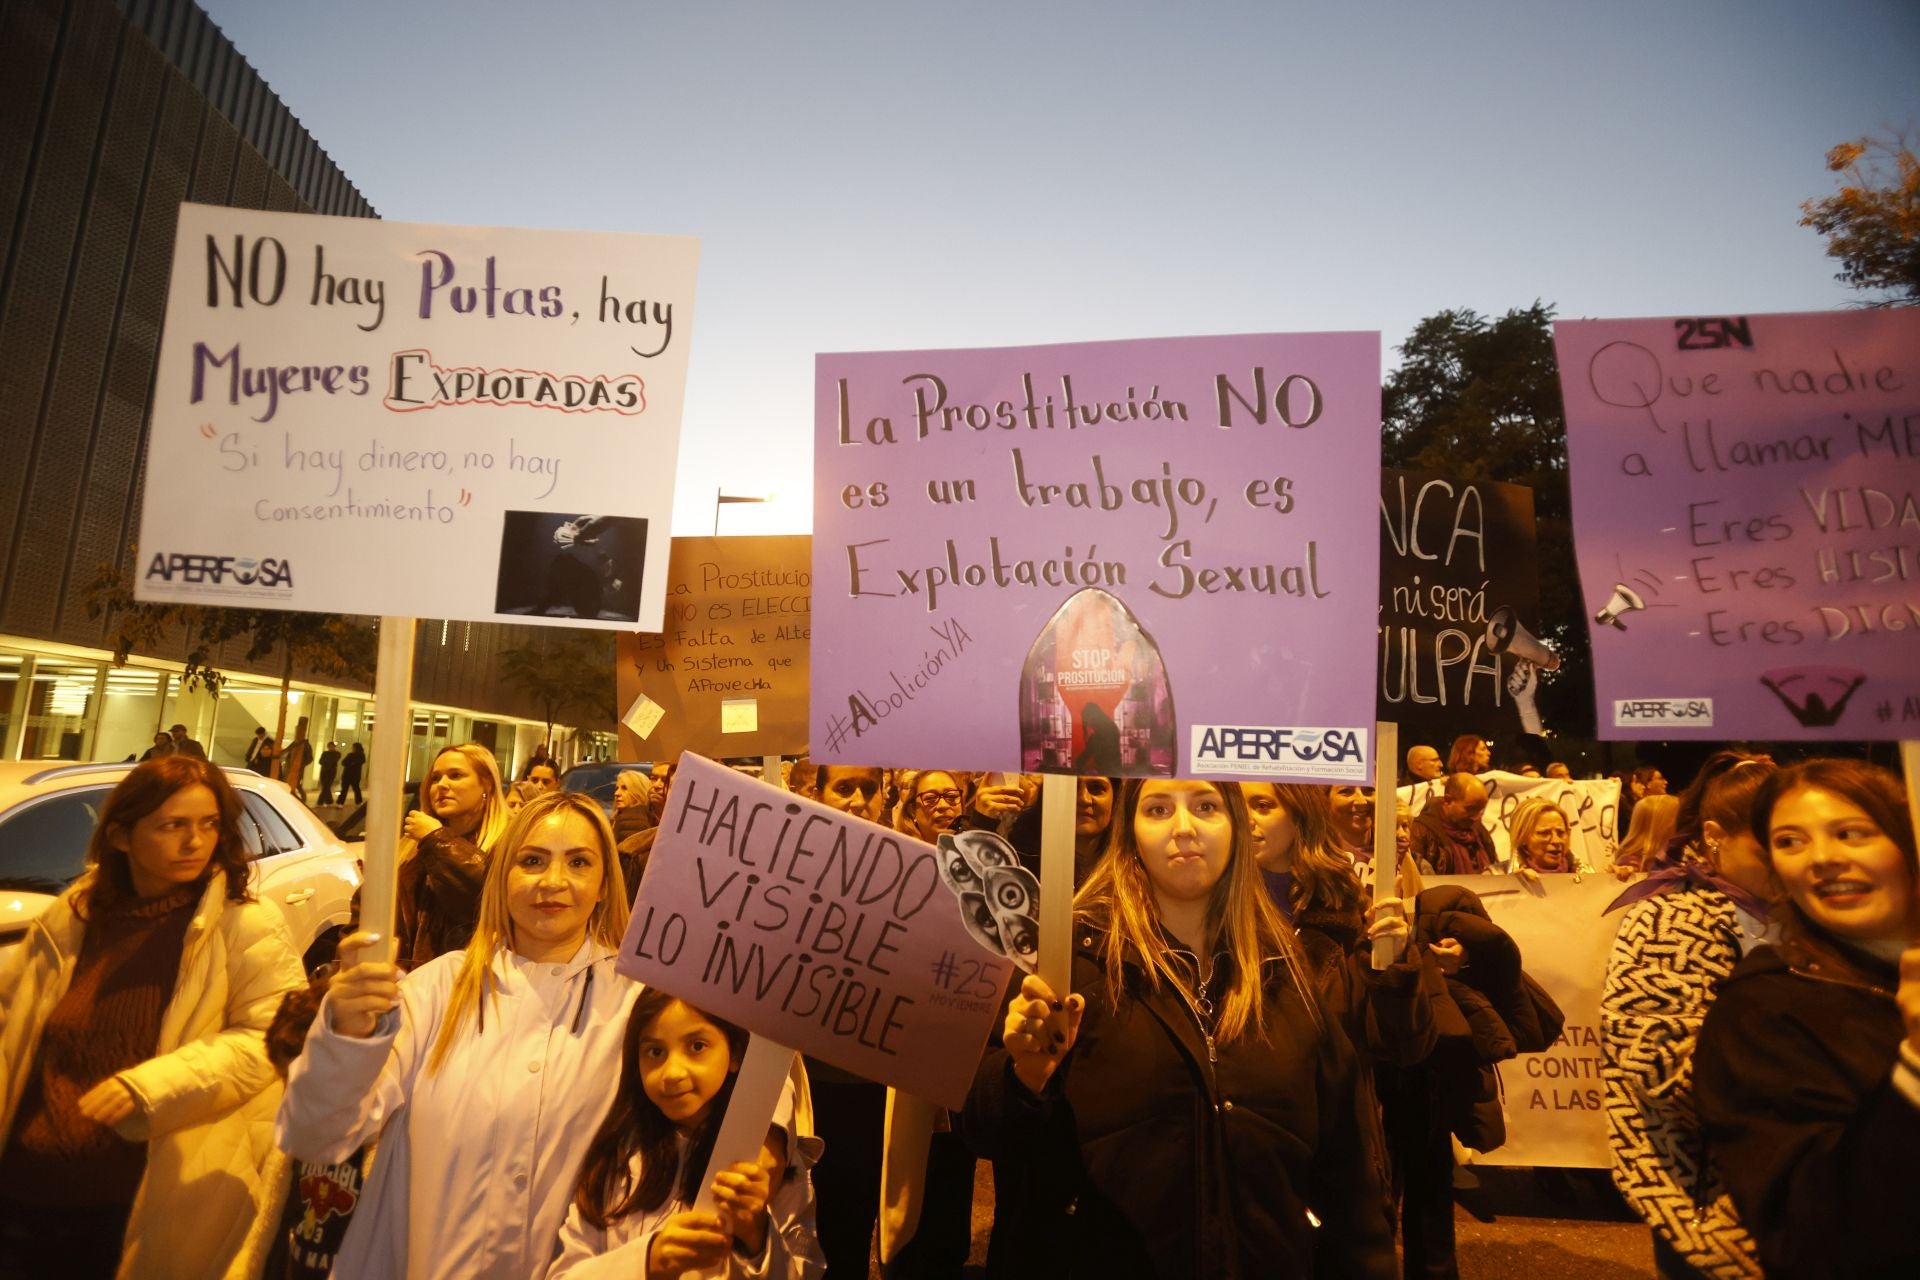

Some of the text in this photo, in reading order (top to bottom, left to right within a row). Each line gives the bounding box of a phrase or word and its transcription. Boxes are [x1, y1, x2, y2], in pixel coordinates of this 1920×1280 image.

[206, 234, 673, 357] NO hay Putas, hay
[1674, 316, 1753, 350] 25N
[190, 342, 638, 423] Mujeres EXPLOTADAS
[838, 366, 1324, 445] La Prostitución NO
[1589, 340, 1903, 433] Que nadie
[284, 433, 344, 497] hay
[359, 438, 454, 475] dinero,
[464, 450, 496, 471] no
[509, 438, 562, 500] hay
[1621, 453, 1653, 476] a
[1683, 419, 1833, 473] llamar
[841, 447, 1295, 541] es un trabajo, es
[1689, 487, 1920, 547] Eres VIDA
[1380, 475, 1486, 572] NCA
[666, 563, 812, 597] a Prostitucio
[846, 536, 1332, 612] Explotación Sexual
[1691, 545, 1920, 593] Eres HIST
[742, 595, 812, 617] ELECCI
[1707, 609, 1805, 647] Eres
[674, 628, 734, 647] Falta
[751, 629, 766, 644] de
[775, 623, 812, 641] ALte
[1072, 648, 1111, 669] STOP
[684, 653, 754, 671] Sistema
[768, 656, 793, 671] que
[1377, 626, 1501, 707] ULPA
[1197, 728, 1363, 763] APERFOSA
[635, 906, 687, 967] LO
[930, 949, 1001, 999] #25
[1554, 1026, 1600, 1047] ATA
[1529, 1089, 1602, 1111] A LAS
